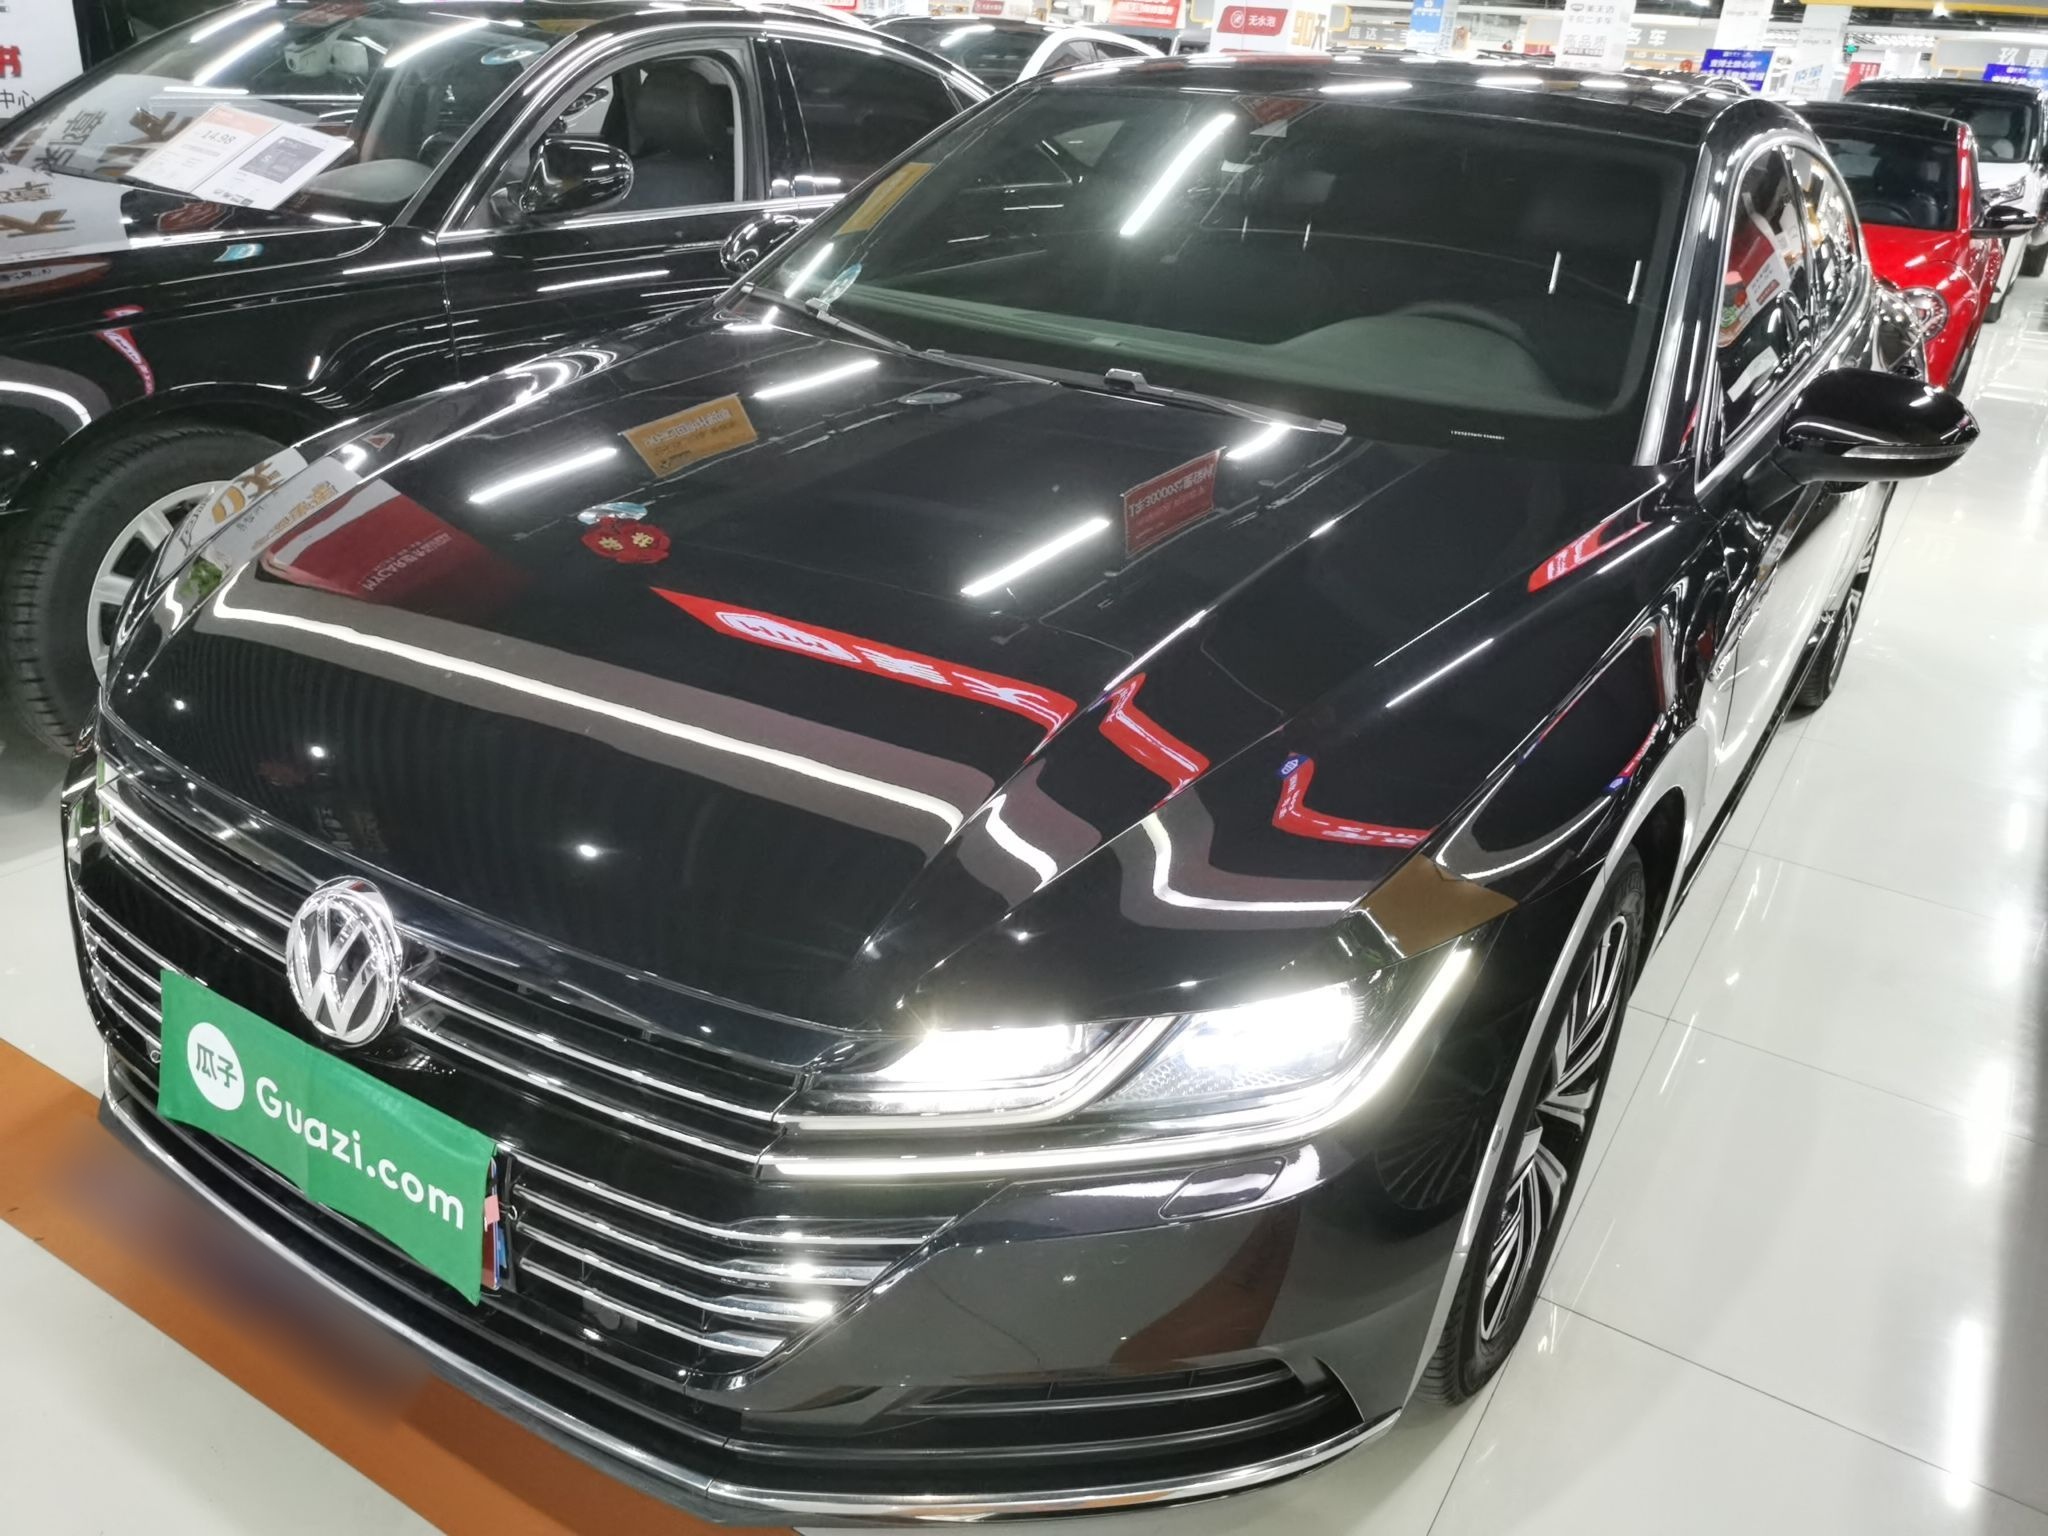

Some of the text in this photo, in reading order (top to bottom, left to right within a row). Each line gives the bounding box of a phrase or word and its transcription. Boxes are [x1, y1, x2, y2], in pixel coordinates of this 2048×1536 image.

[1247, 14, 1276, 27] 无水泡
[195, 1042, 238, 1089] 瓜子
[256, 1076, 464, 1230] Guazi.com
